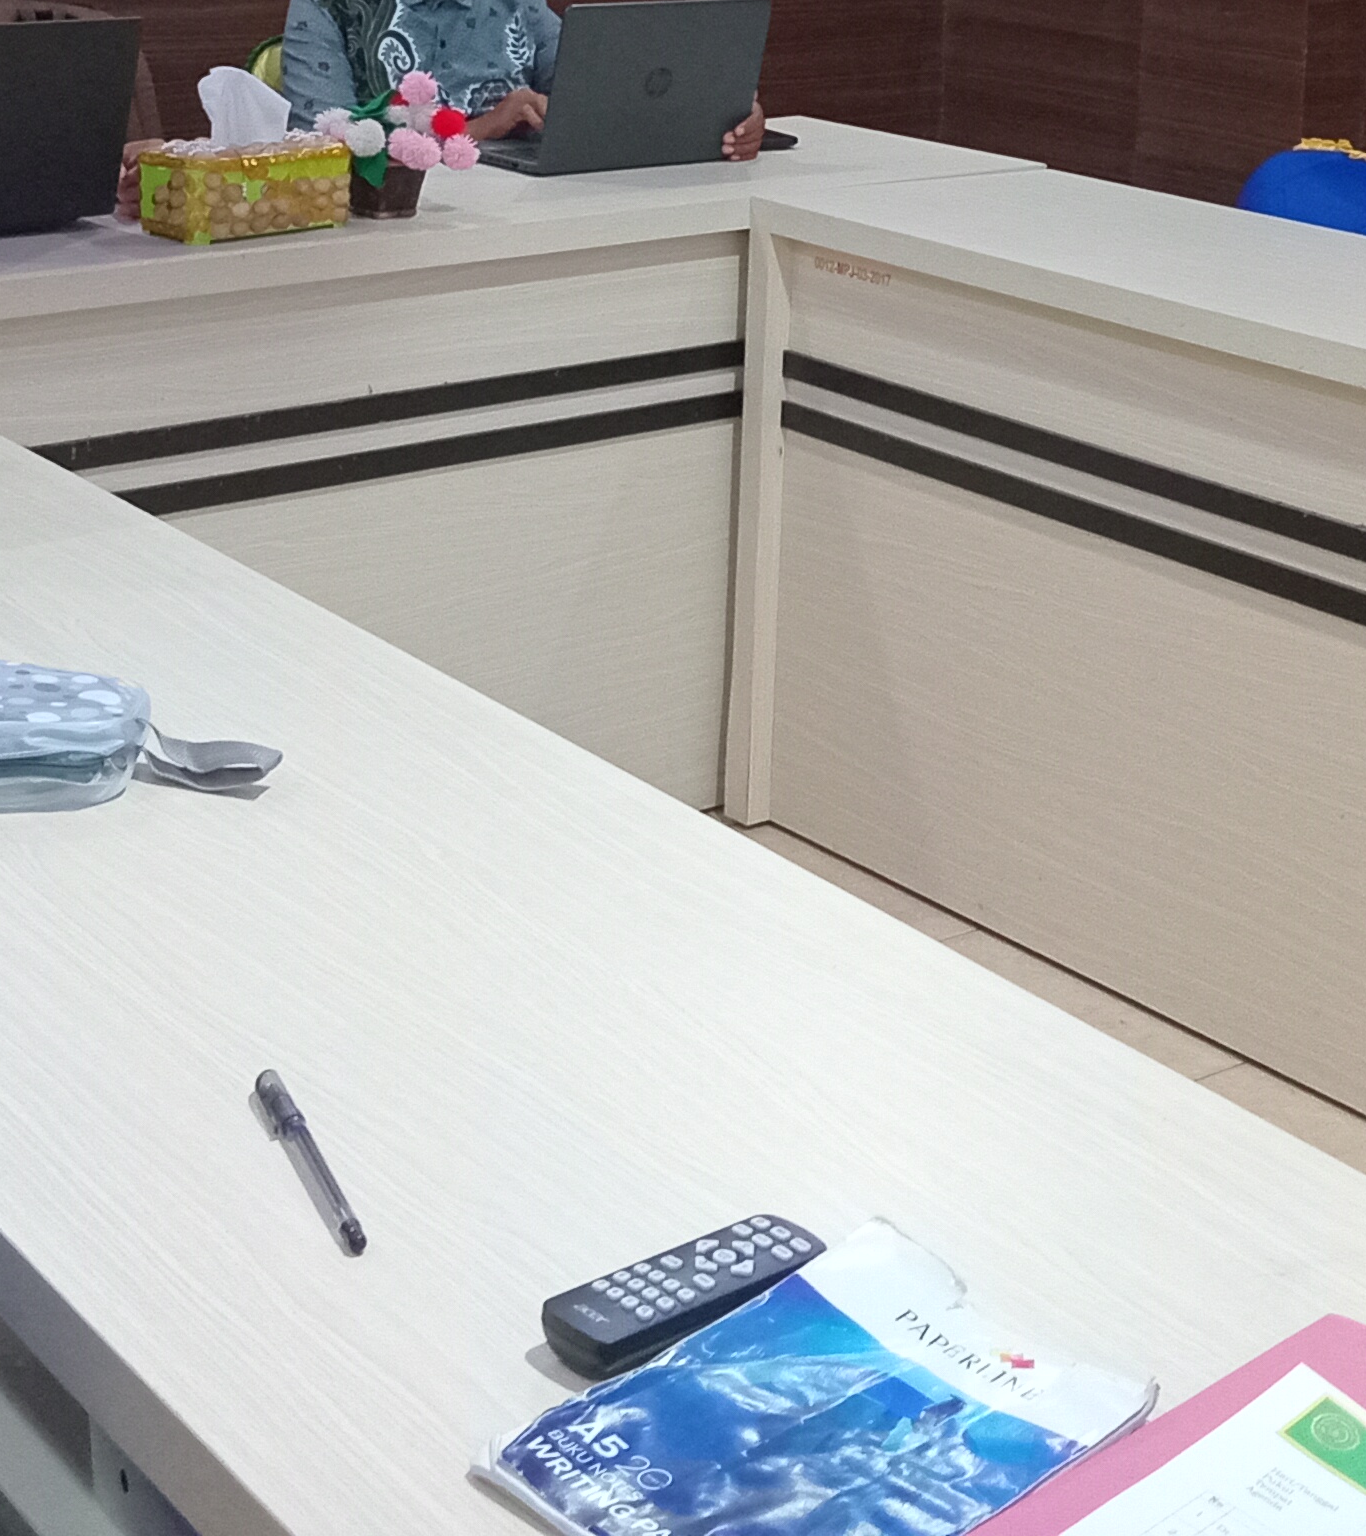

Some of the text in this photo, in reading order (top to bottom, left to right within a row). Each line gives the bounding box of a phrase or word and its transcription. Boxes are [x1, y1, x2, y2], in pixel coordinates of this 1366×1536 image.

[573, 1303, 610, 1323] acer
[894, 1308, 1045, 1401] PAPERLINE
[526, 1435, 636, 1519] WRITING
[547, 1428, 594, 1464] BUKU
[566, 1419, 673, 1491] A5 20
